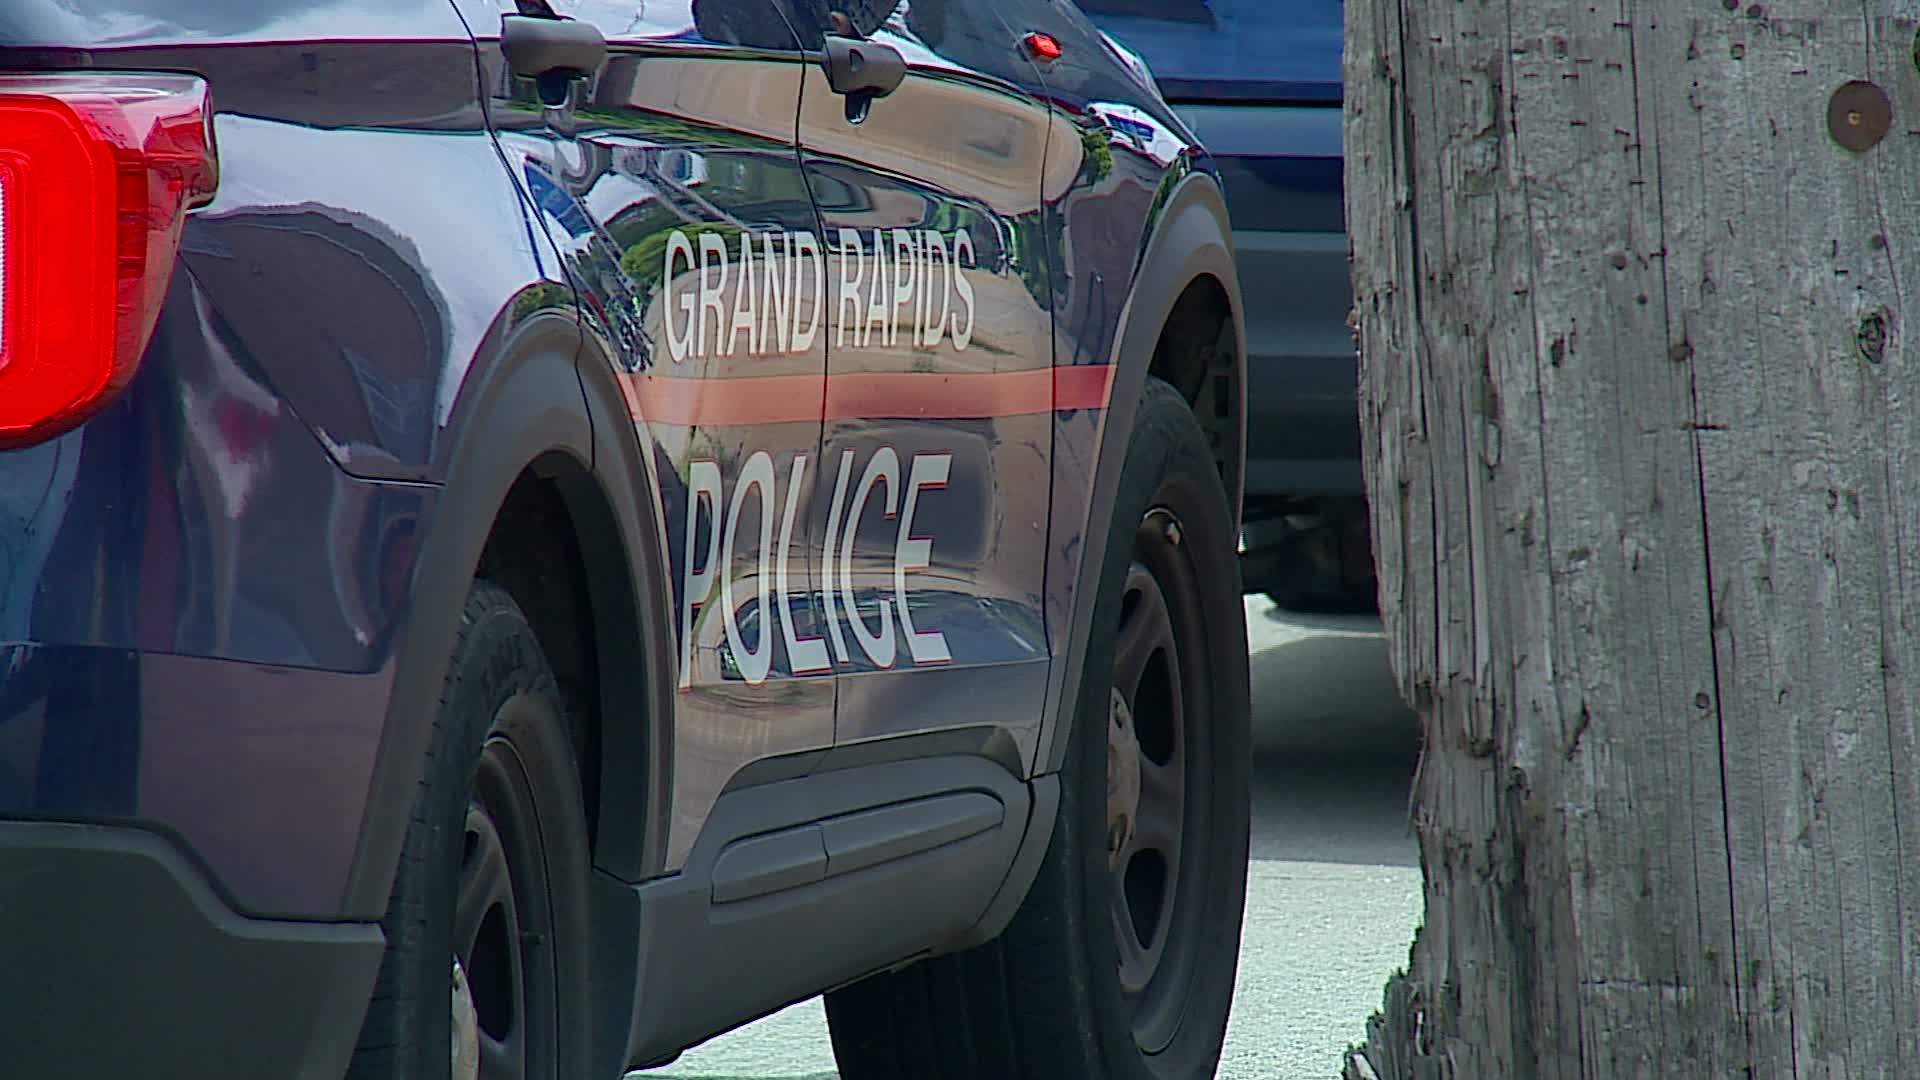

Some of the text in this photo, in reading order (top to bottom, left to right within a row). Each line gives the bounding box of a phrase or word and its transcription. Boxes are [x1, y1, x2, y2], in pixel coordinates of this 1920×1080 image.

[664, 228, 976, 362] GRAND RAPIDS
[678, 445, 952, 692] POLICE
